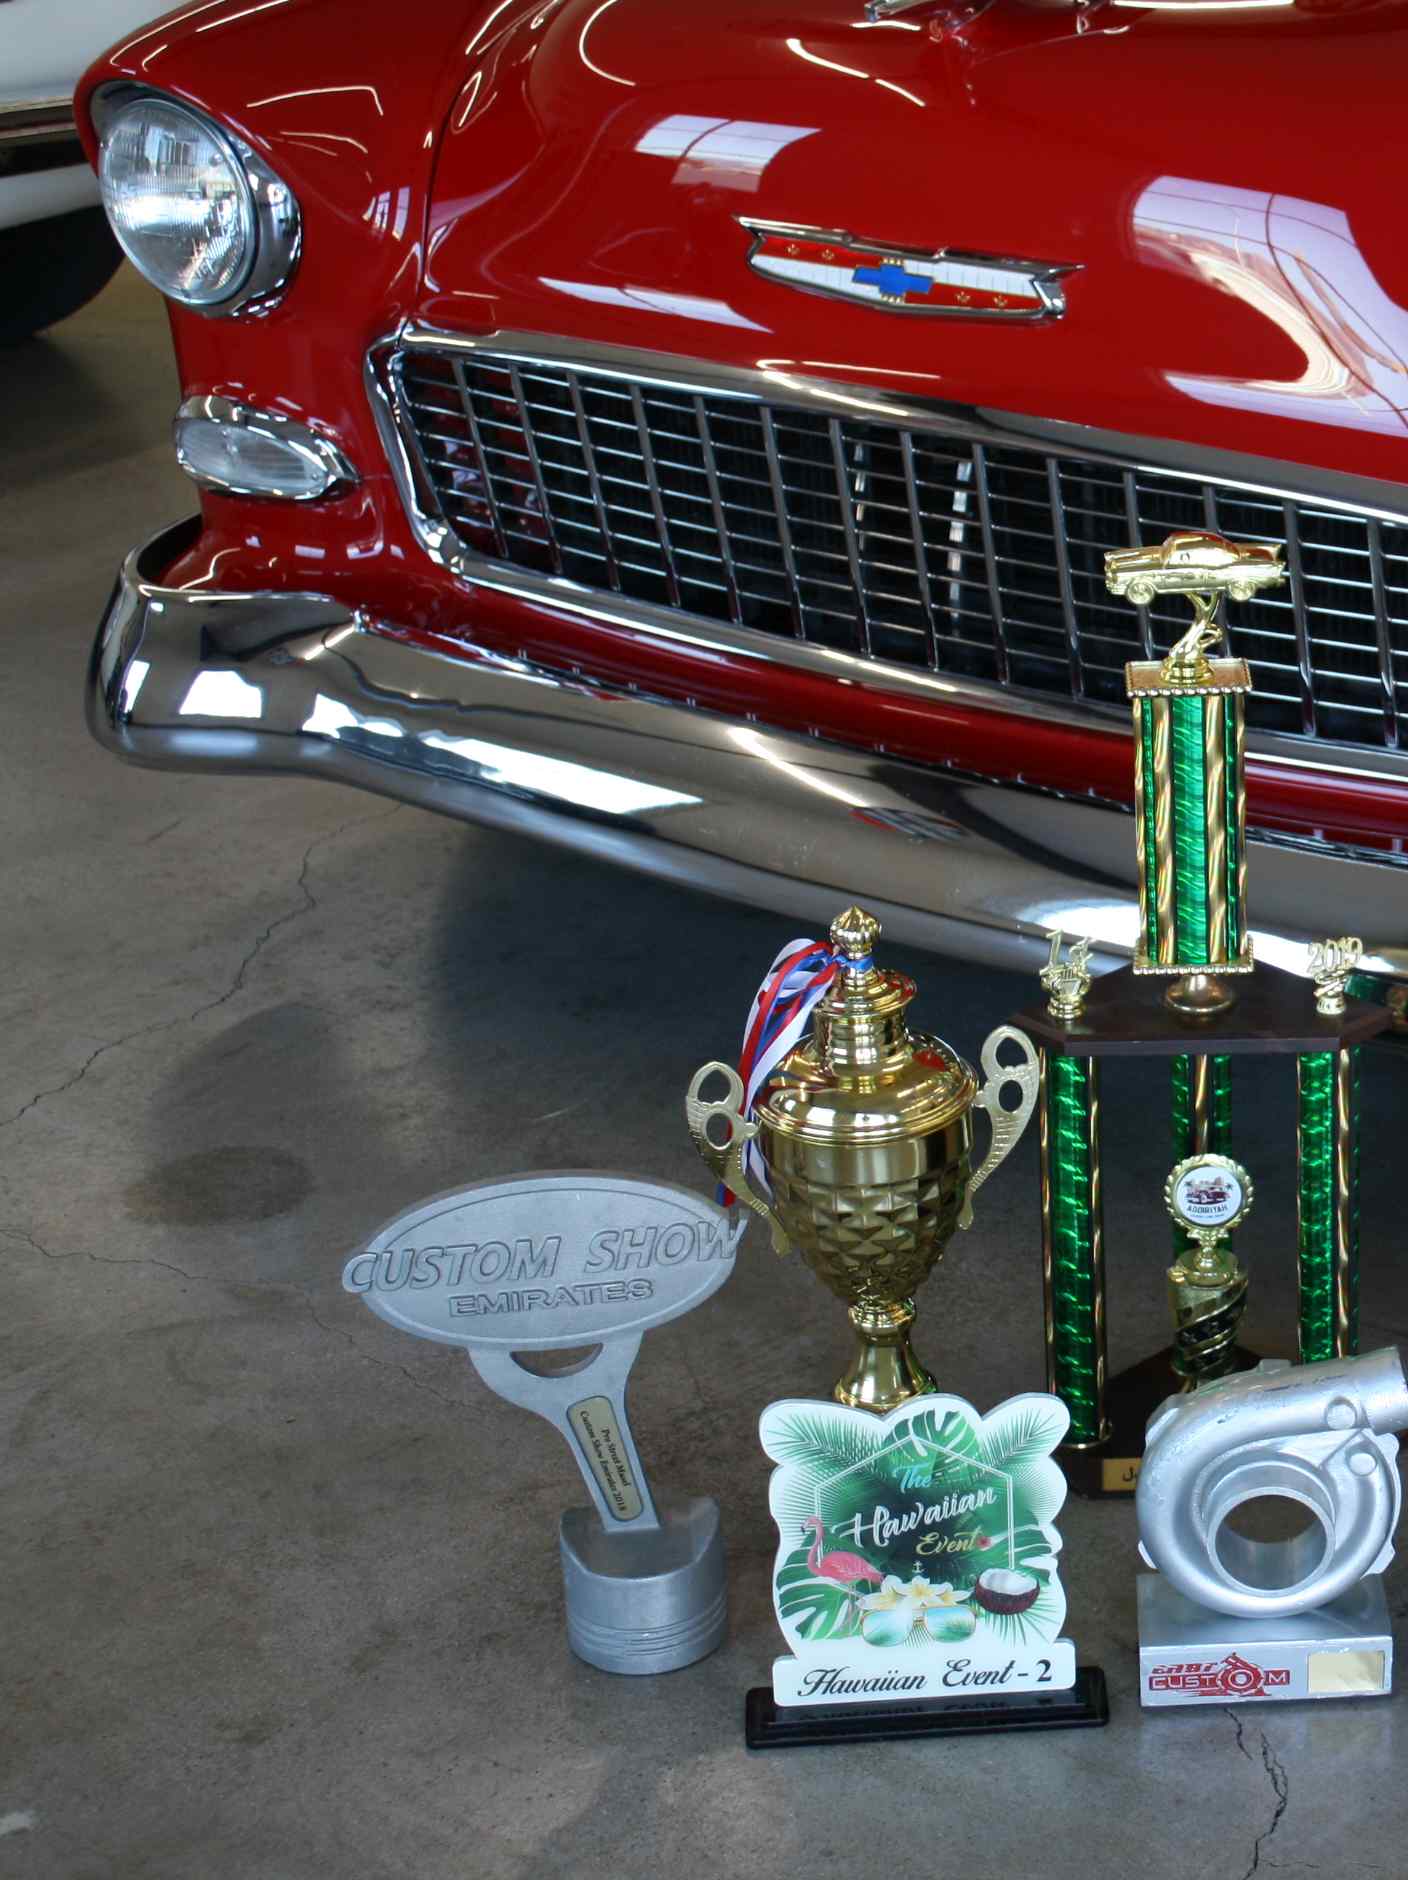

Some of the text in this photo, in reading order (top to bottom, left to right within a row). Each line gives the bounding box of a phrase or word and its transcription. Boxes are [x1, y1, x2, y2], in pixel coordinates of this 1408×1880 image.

[342, 1215, 750, 1293] CUSTOM SHOW
[449, 1278, 654, 1319] EMIRATES
[893, 1462, 934, 1494] The
[831, 1487, 999, 1549] Hawaiian
[915, 1525, 984, 1556] Event
[798, 1666, 927, 1697] Hawaiian
[942, 1658, 1016, 1688] Event
[1036, 1658, 1052, 1682] 2
